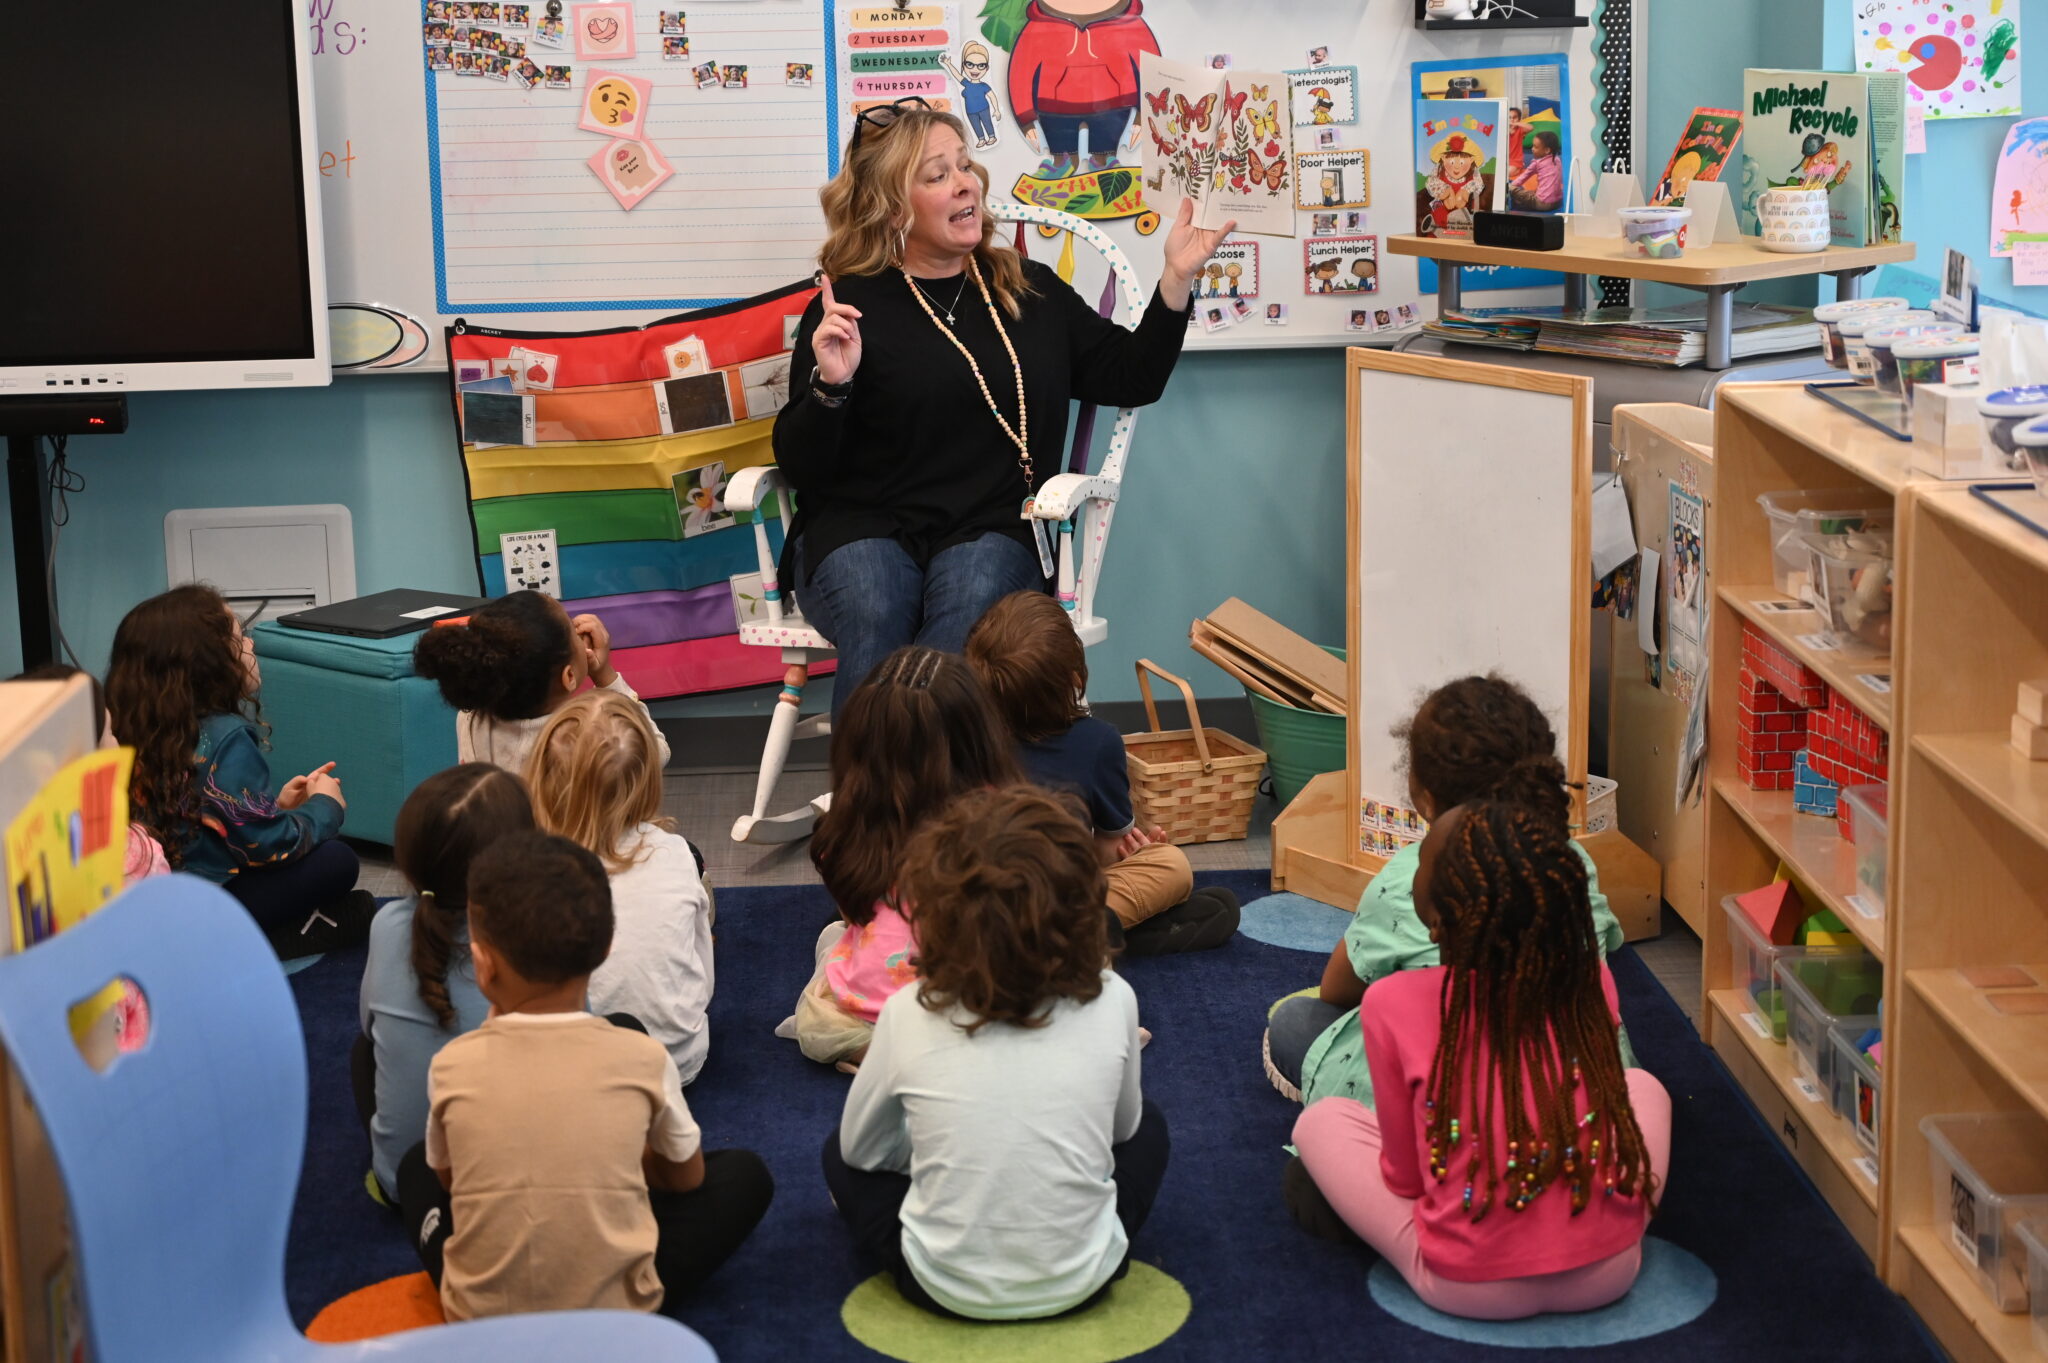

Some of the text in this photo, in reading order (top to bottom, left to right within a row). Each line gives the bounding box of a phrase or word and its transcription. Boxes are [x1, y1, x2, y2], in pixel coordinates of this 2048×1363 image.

[870, 11, 924, 22] MONDAY
[854, 34, 926, 45] 2 TUESDAY
[853, 56, 936, 68] 3 WEDNESDAY
[856, 81, 932, 91] 4 THURSDAY
[1294, 76, 1349, 87] eteorologist
[1752, 80, 1829, 117] Michael
[855, 105, 861, 113] 5
[1788, 106, 1859, 138] Recycle
[1300, 156, 1361, 169] Door Helper
[1490, 224, 1528, 239] ANKER
[1311, 245, 1372, 256] Lunch Helper
[659, 401, 668, 415] soil
[1675, 496, 1699, 531] BLOCKS
[701, 522, 716, 532] bee
